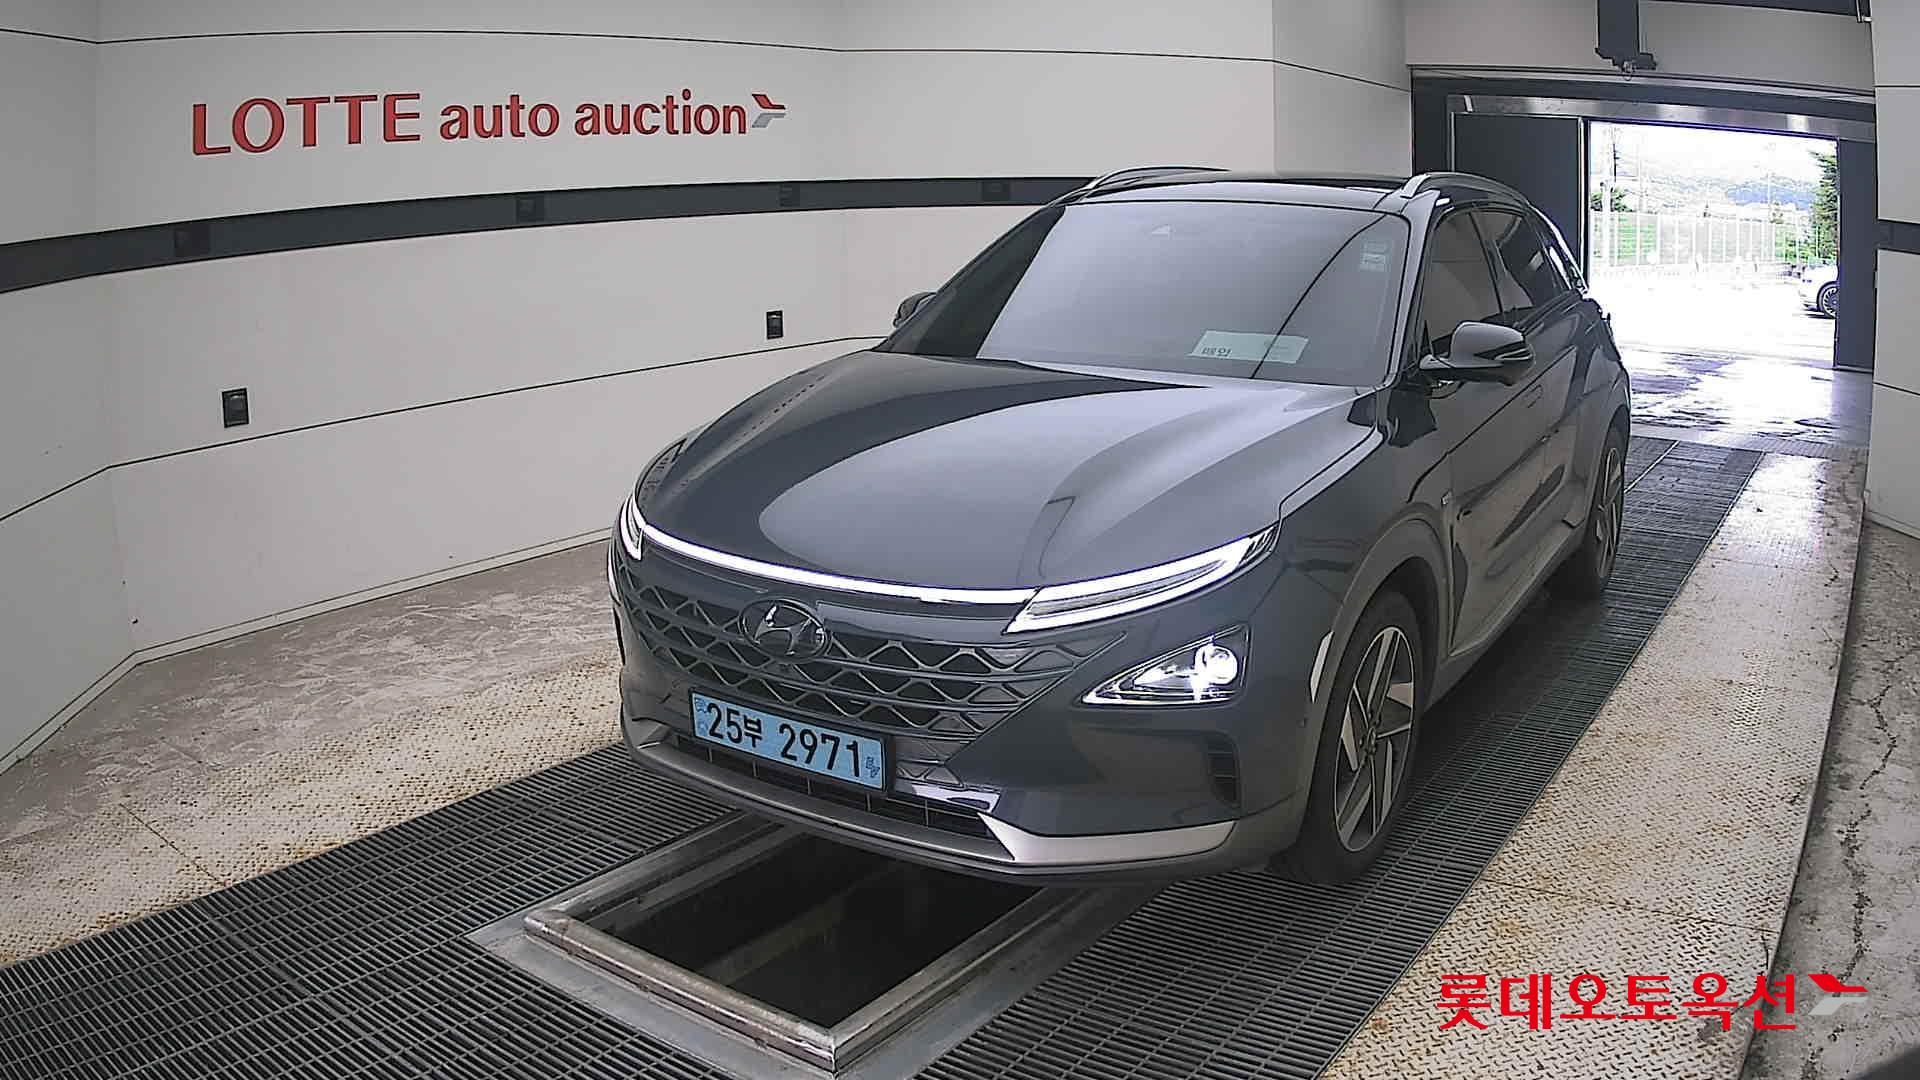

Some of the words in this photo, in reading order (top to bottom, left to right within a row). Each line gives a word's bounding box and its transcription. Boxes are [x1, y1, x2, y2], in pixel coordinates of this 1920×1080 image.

[192, 93, 421, 156] LOTTE
[440, 95, 560, 139] auto
[574, 89, 747, 135] auction
[707, 703, 763, 748] 25부
[779, 723, 860, 778] 2971
